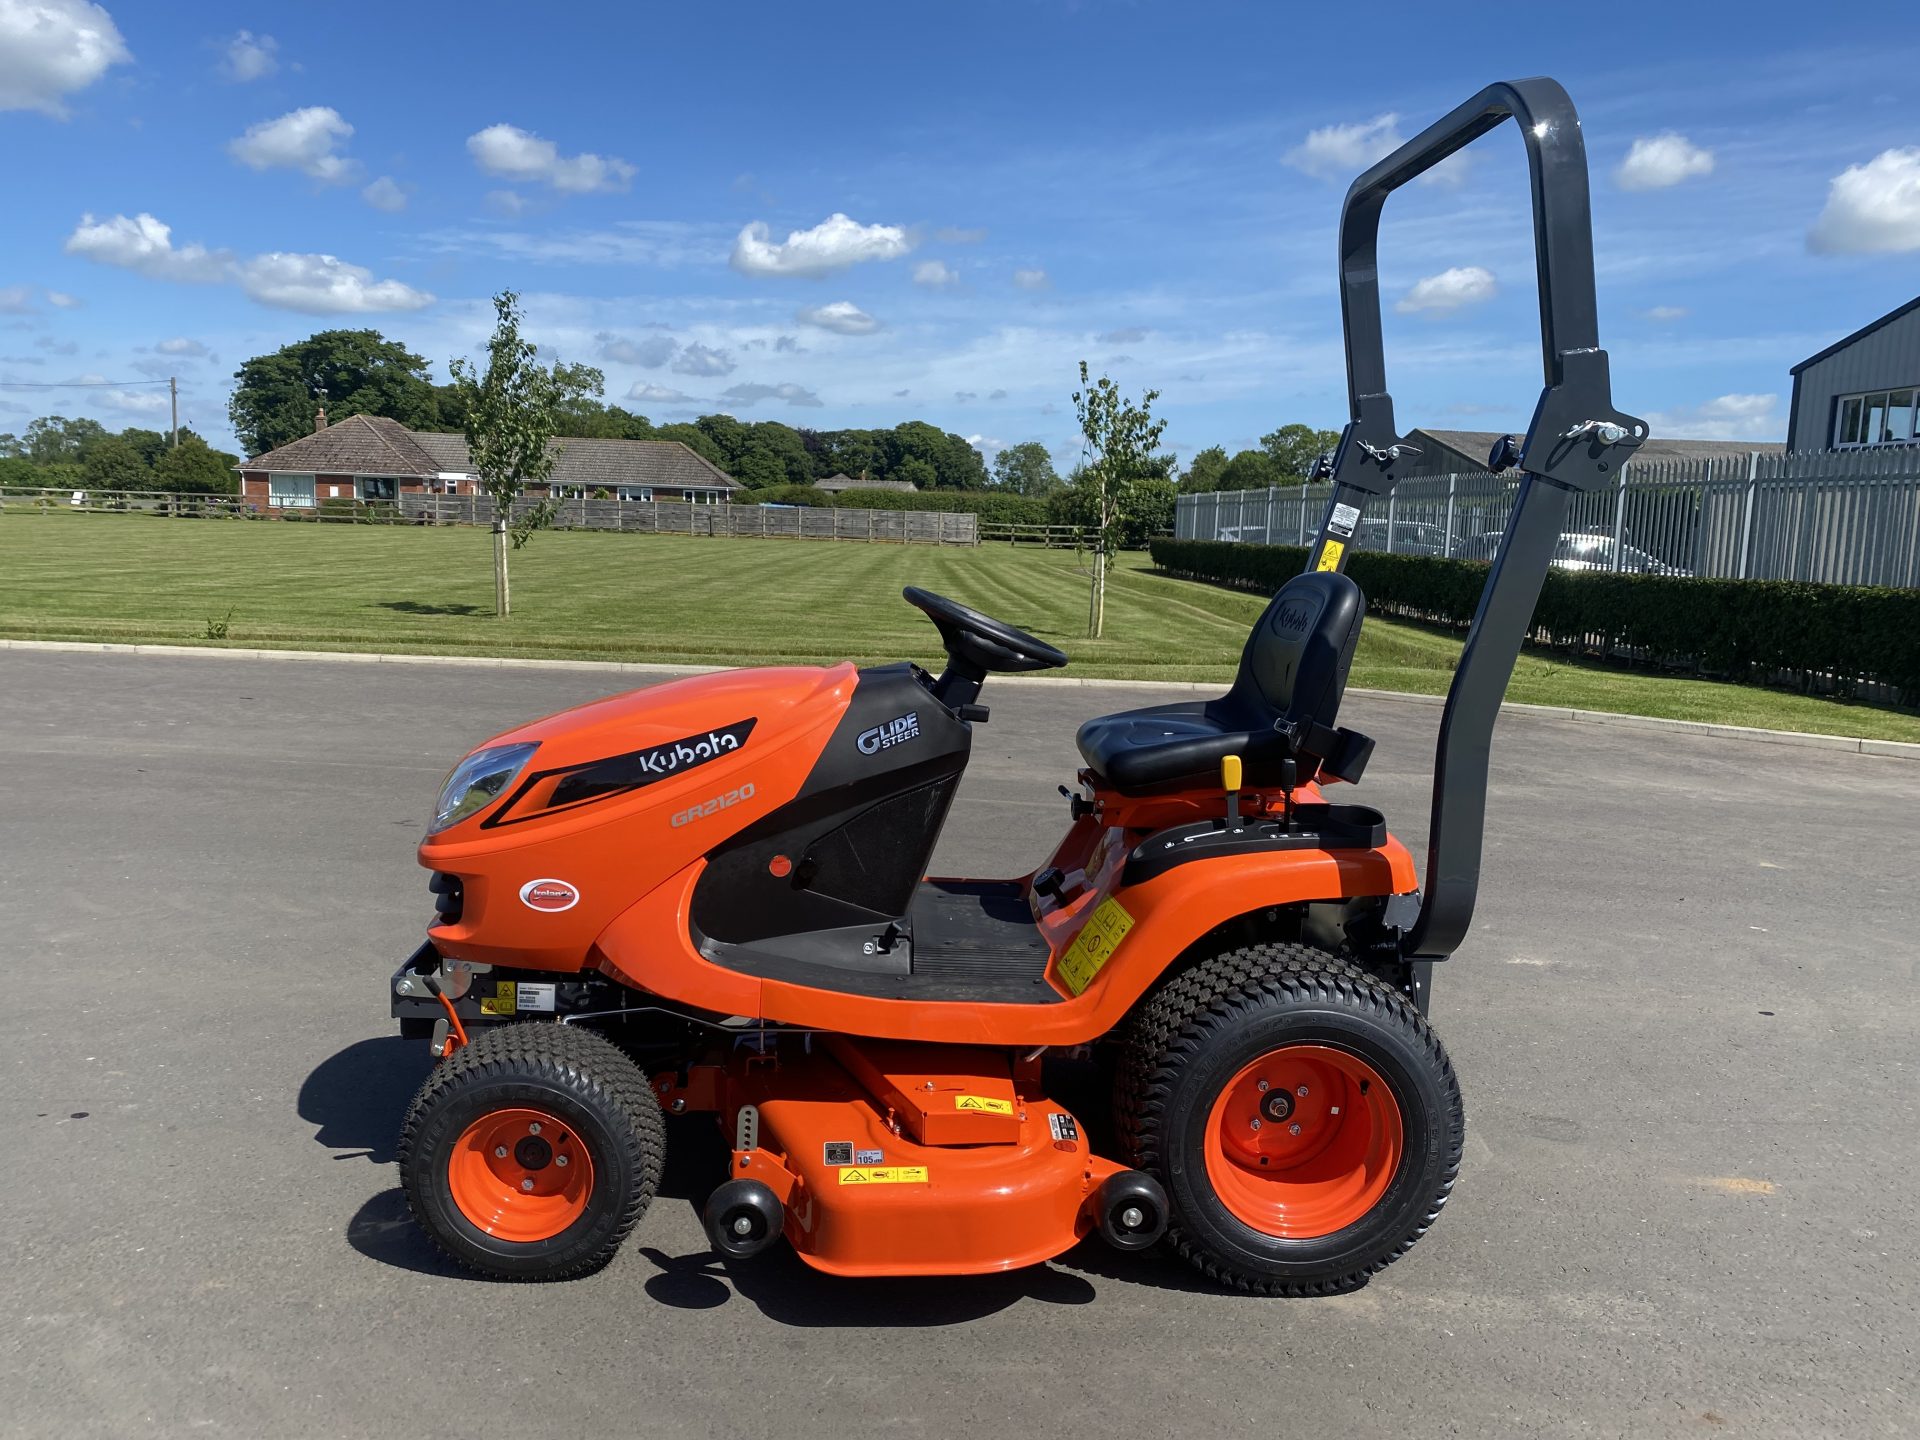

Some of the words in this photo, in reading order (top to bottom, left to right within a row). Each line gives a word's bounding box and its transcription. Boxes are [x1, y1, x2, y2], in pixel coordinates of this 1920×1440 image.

[640, 733, 739, 773] Kubota
[858, 712, 918, 755] GLIDE
[882, 728, 920, 748] STEER
[671, 783, 755, 827] GR2120
